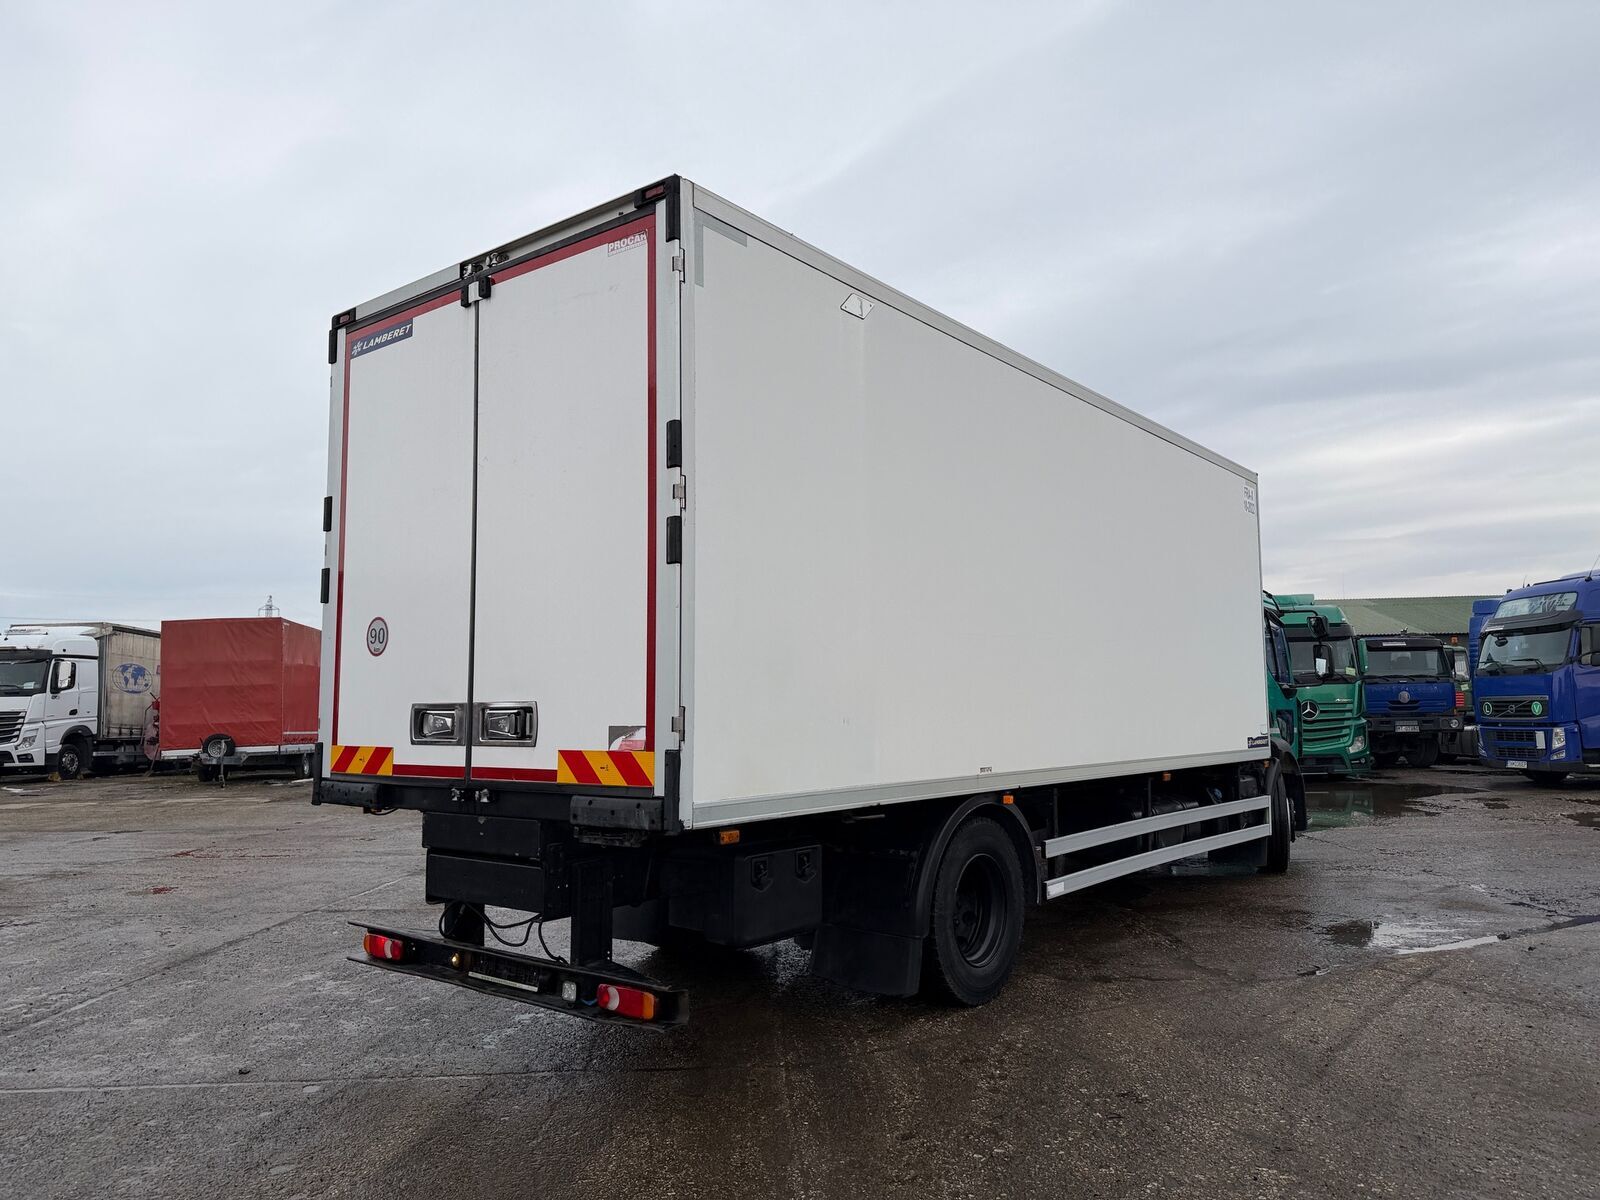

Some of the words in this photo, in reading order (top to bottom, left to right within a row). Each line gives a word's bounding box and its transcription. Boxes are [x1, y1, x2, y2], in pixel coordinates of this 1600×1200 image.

[362, 323, 412, 350] LAMBERET
[370, 627, 385, 644] 90
[1485, 704, 1490, 713] L
[1533, 704, 1540, 713] V
